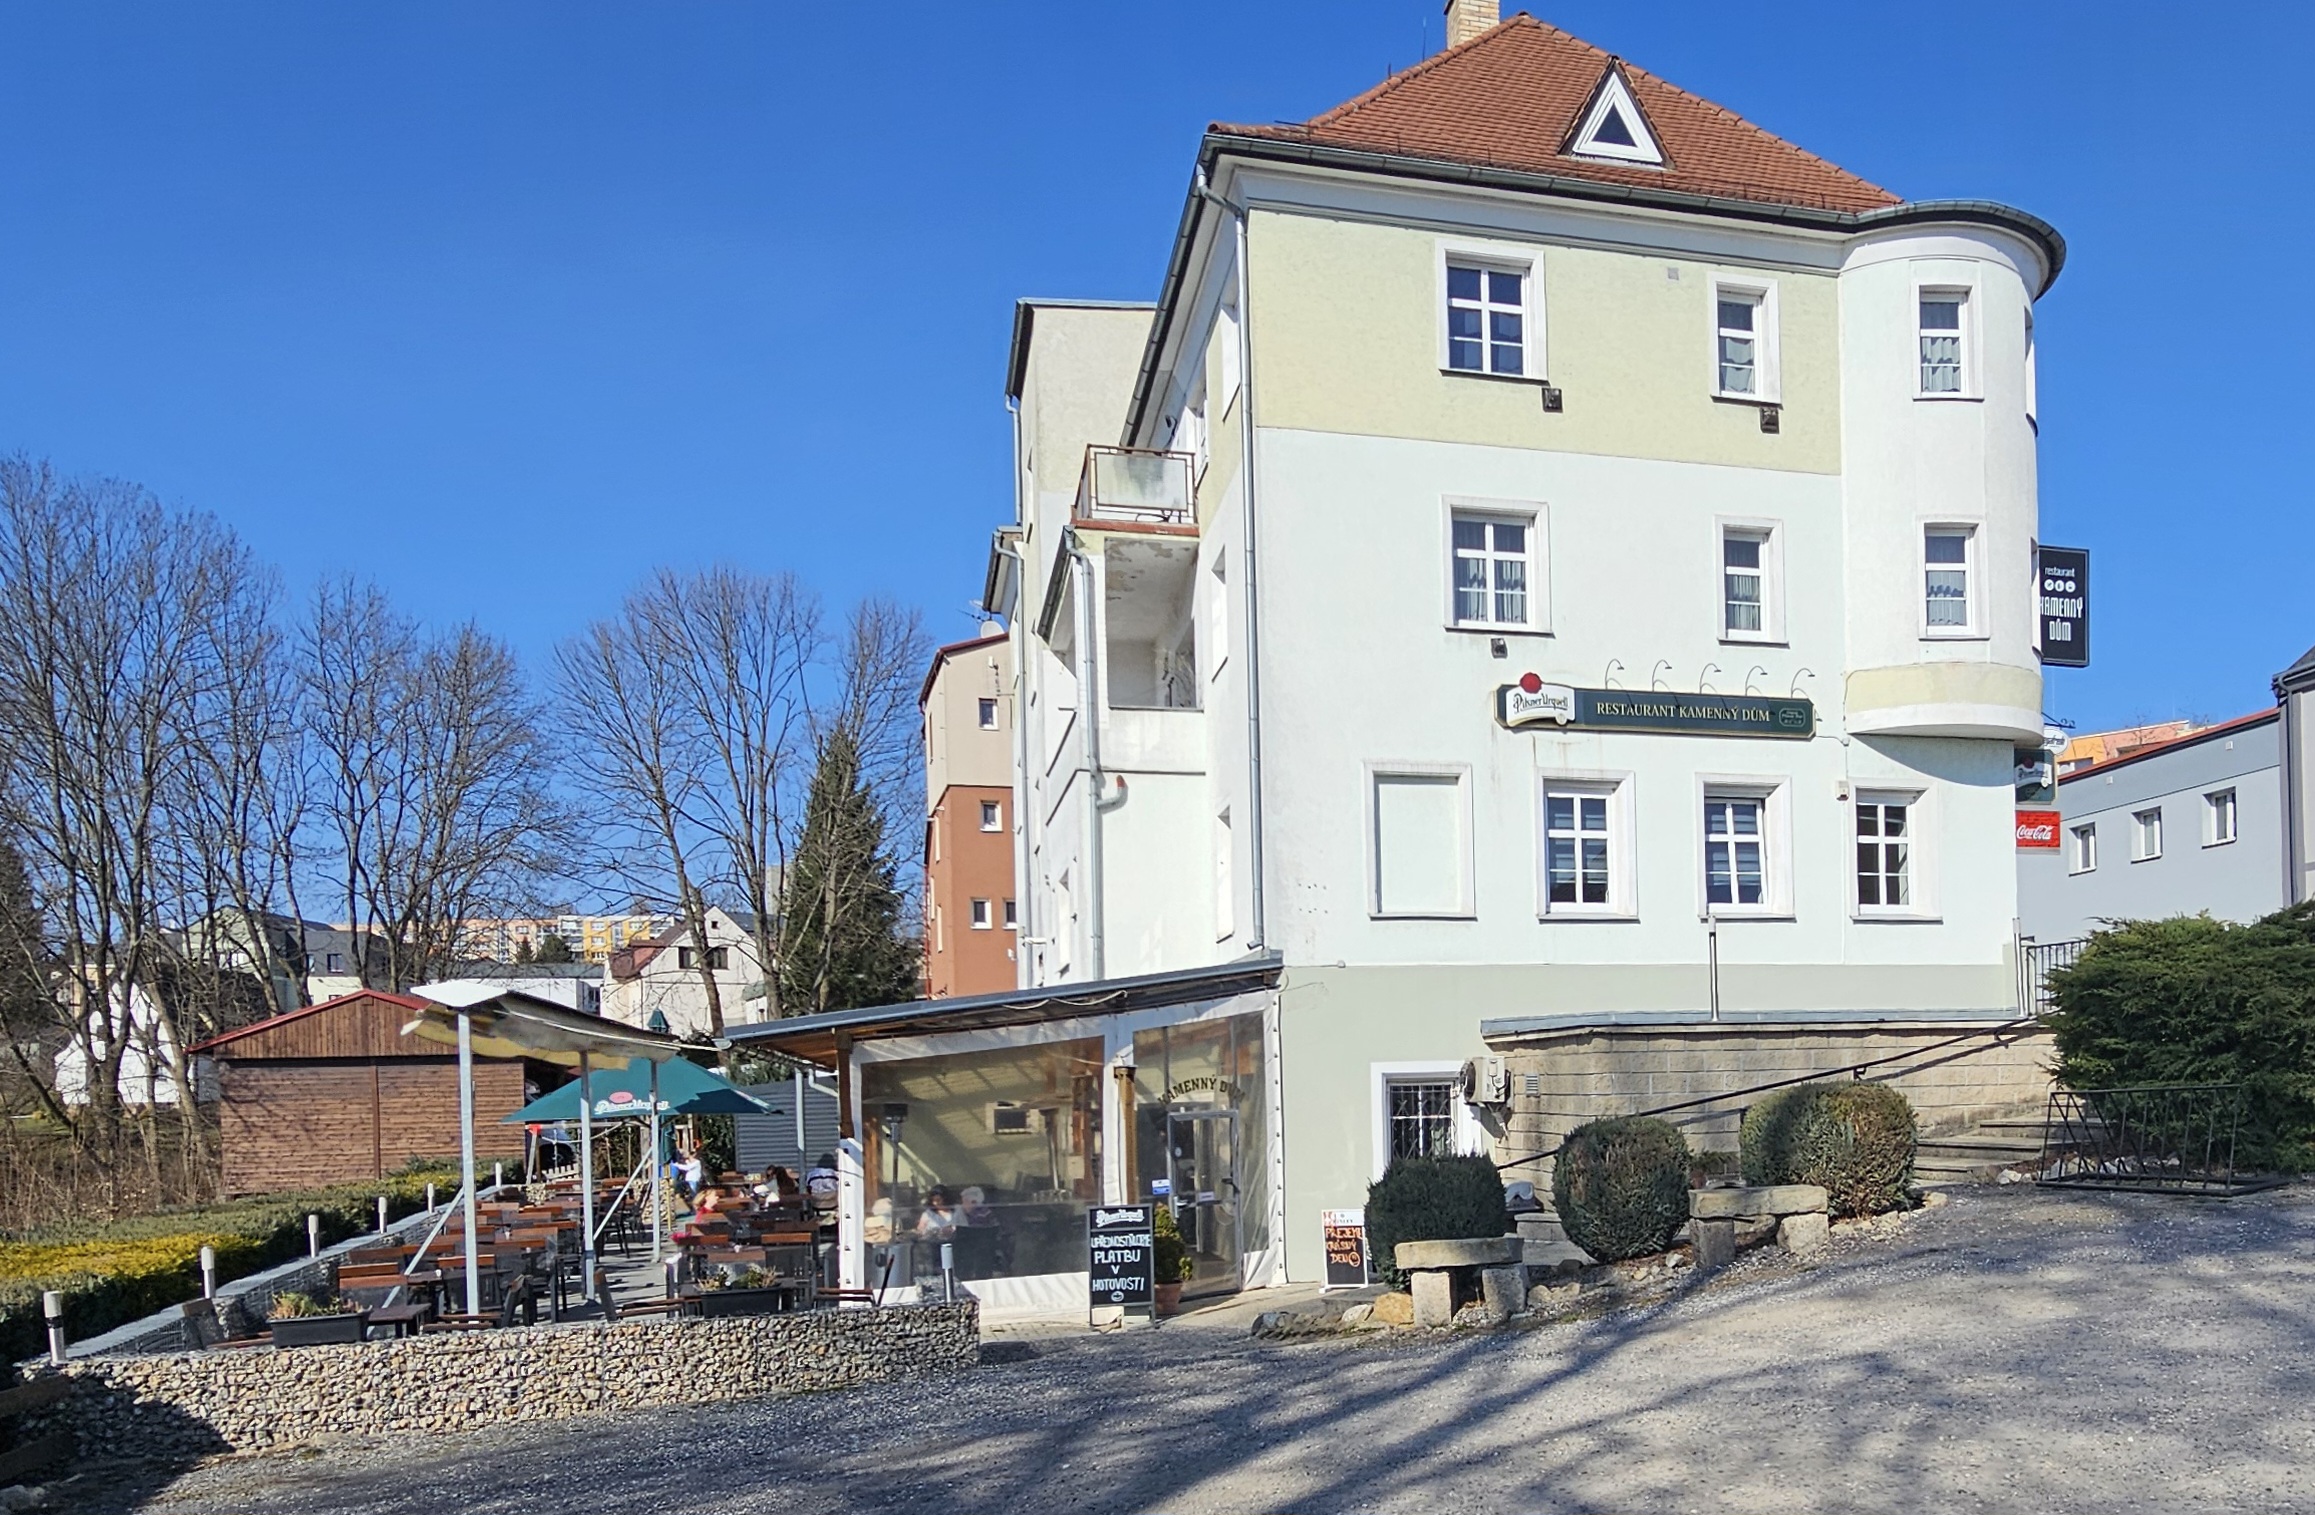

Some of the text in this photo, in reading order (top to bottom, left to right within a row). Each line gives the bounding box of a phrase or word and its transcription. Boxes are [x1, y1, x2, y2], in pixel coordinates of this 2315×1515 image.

[2045, 567, 2075, 577] restaurant
[1513, 693, 1568, 714] Pilsner Urquell
[1596, 702, 1675, 718] RESTAURANT
[1679, 704, 1739, 721] KAMENNÝ
[1742, 705, 1770, 722] DŮM
[1157, 1074, 1217, 1106] KAMENNÝ
[1094, 1250, 1141, 1264] PLATBU
[1092, 1277, 1145, 1292] HOTOVOSTI
